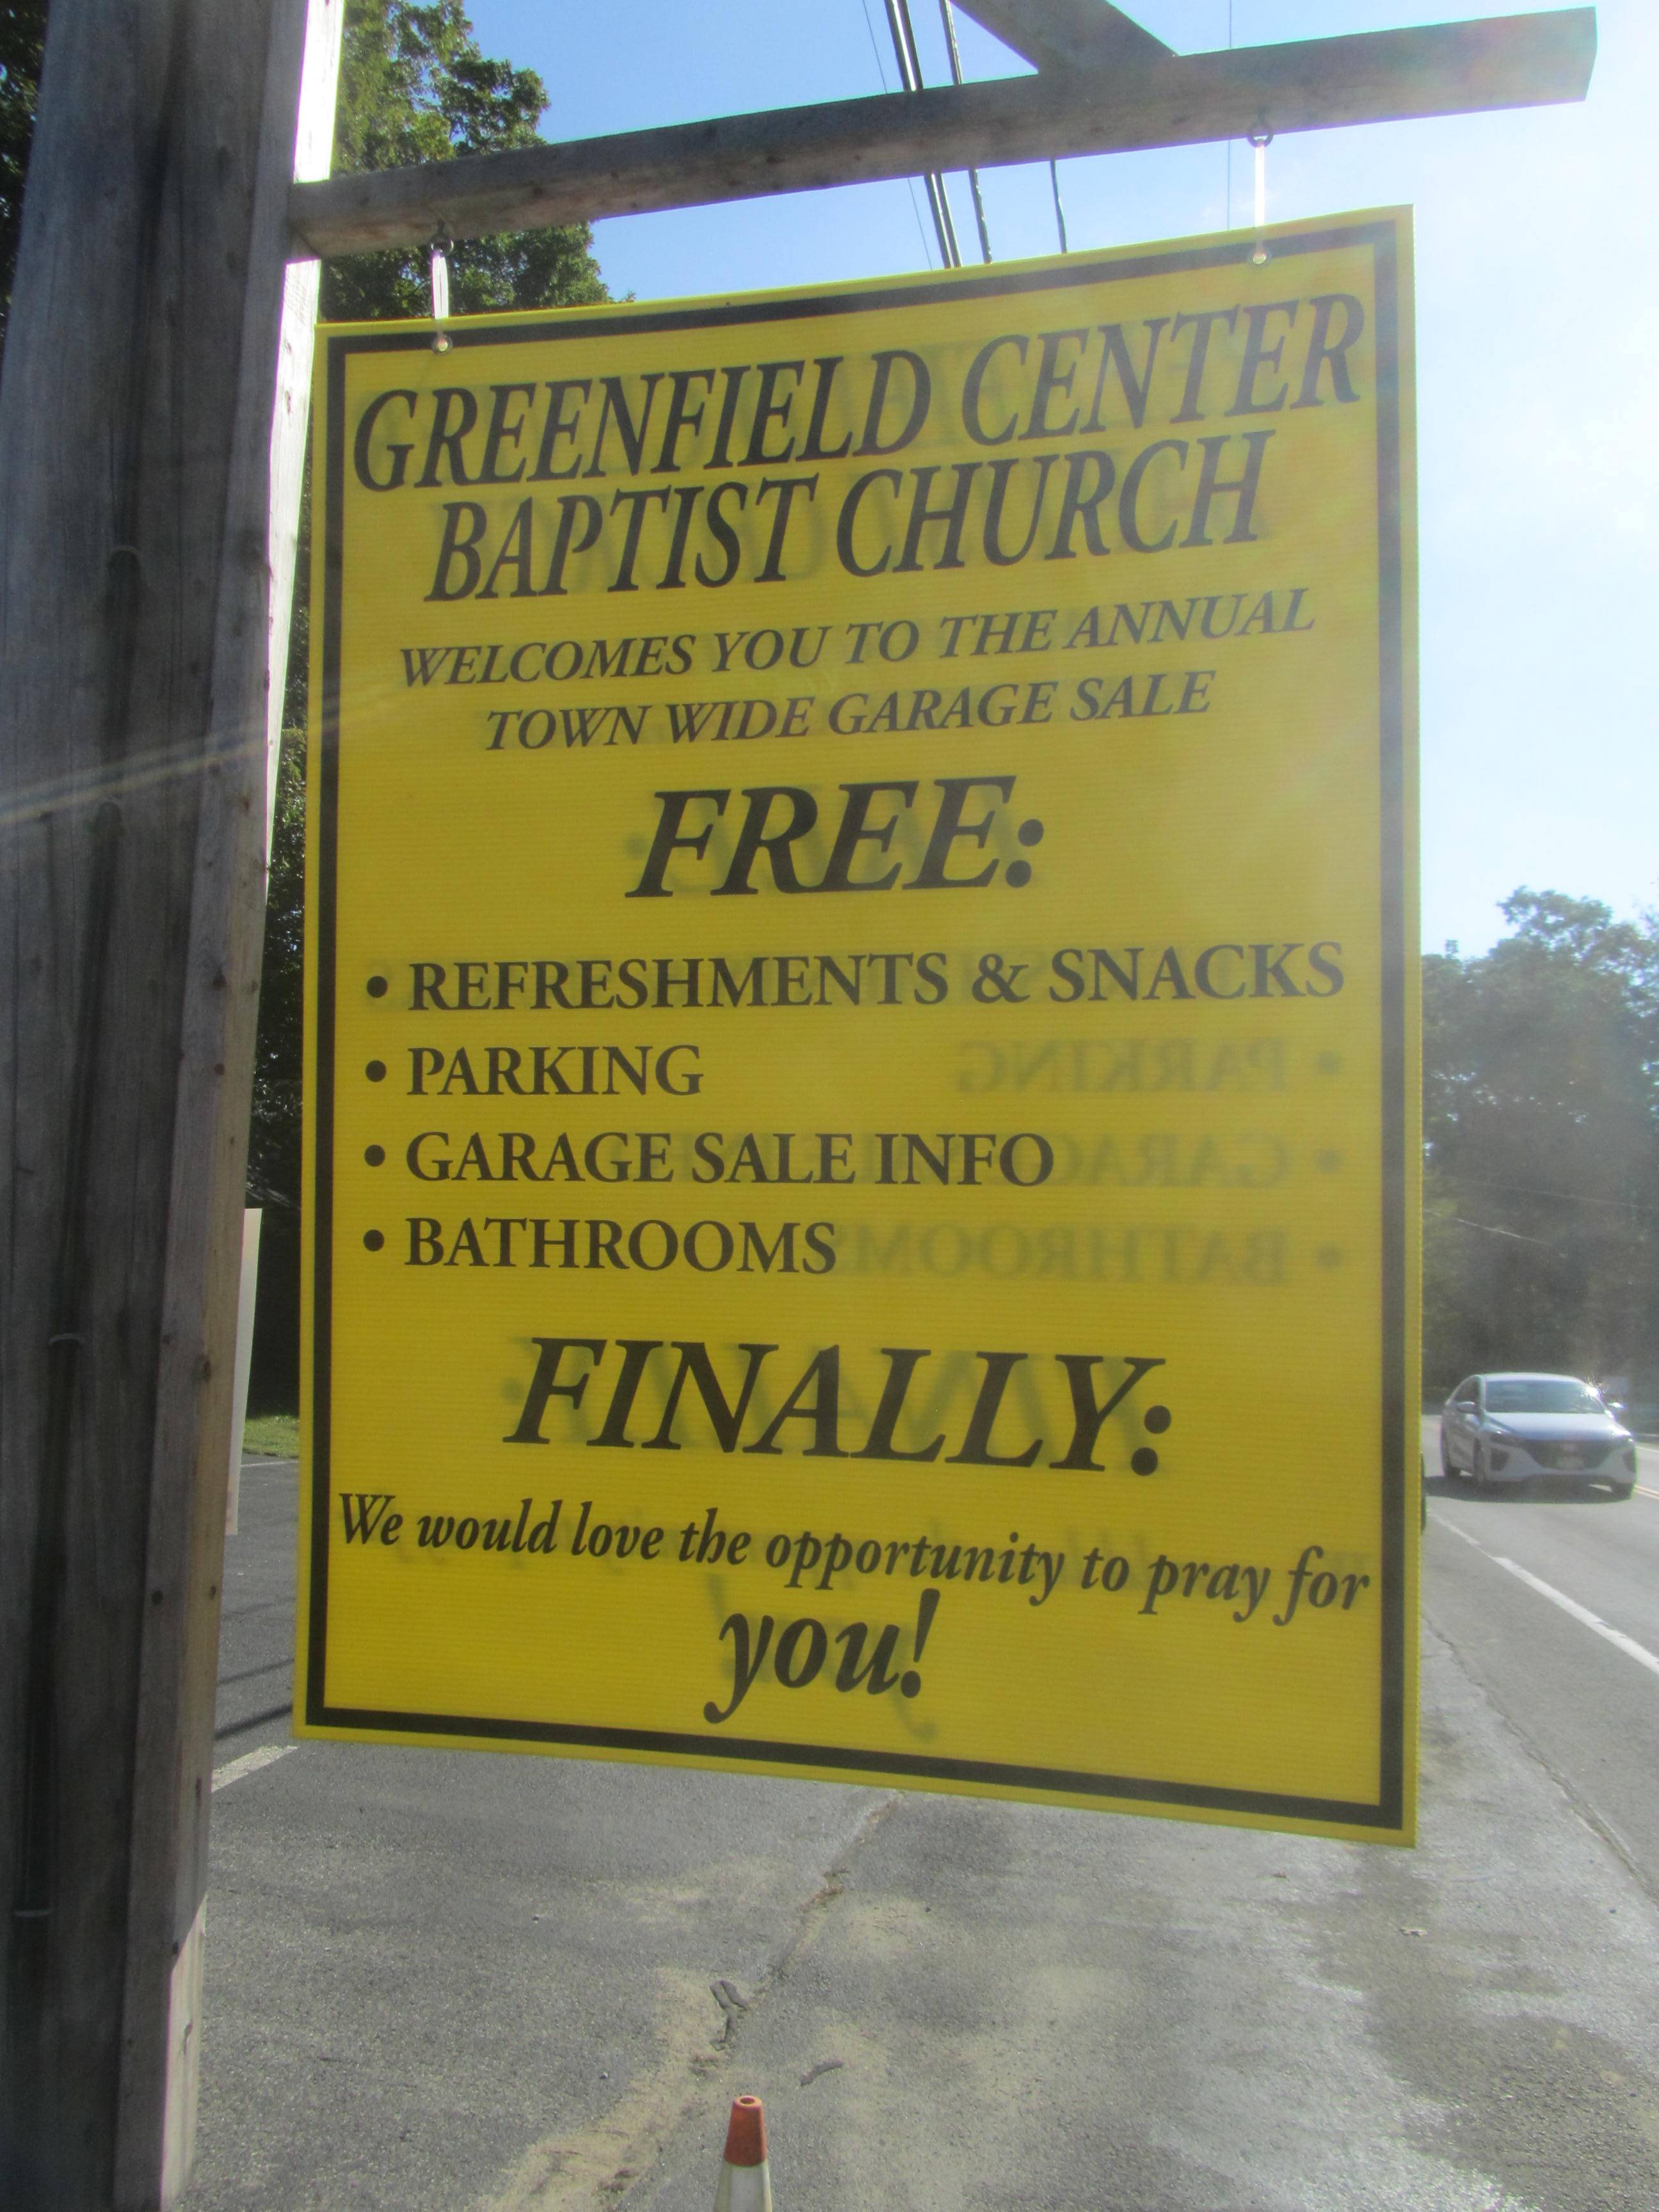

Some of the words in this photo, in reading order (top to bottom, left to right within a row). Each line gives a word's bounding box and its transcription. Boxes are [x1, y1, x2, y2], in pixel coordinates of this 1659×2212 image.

[354, 351, 930, 492] GREENFIELD
[963, 292, 1365, 446] CENTER
[424, 474, 819, 602] BAPTIST
[837, 429, 1277, 577] CHURCH
[401, 635, 696, 686] WELCOMES
[713, 627, 830, 671] YOU
[847, 621, 918, 662] TO
[940, 609, 1056, 658] THE
[1063, 588, 1315, 648] ANNUAL
[487, 706, 651, 749] TOWN
[666, 697, 815, 743] WIDE
[829, 682, 1058, 735] GARAGE
[1070, 670, 1216, 721] SALE
[625, 776, 1043, 898] FREE:
[409, 953, 947, 1010] REFRESHMENTS
[972, 954, 1028, 1003] &
[1050, 942, 1343, 1002] SNACKS
[408, 1045, 703, 1095] PARKING
[406, 1132, 673, 1182] GARAGE
[693, 1133, 854, 1183] SALE
[876, 1134, 1053, 1186] INFO
[405, 1217, 835, 1274] BATHROOMS
[503, 1338, 1171, 1476] FINALLY:
[340, 1493, 403, 1545] We
[418, 1498, 563, 1554] would
[571, 1502, 664, 1560] love
[678, 1508, 751, 1565] the
[765, 1532, 1064, 1606] opportunity
[1081, 1548, 1129, 1591] to
[1139, 1555, 1270, 1622] pray
[1274, 1546, 1369, 1626] for
[704, 1589, 940, 1724] you!
